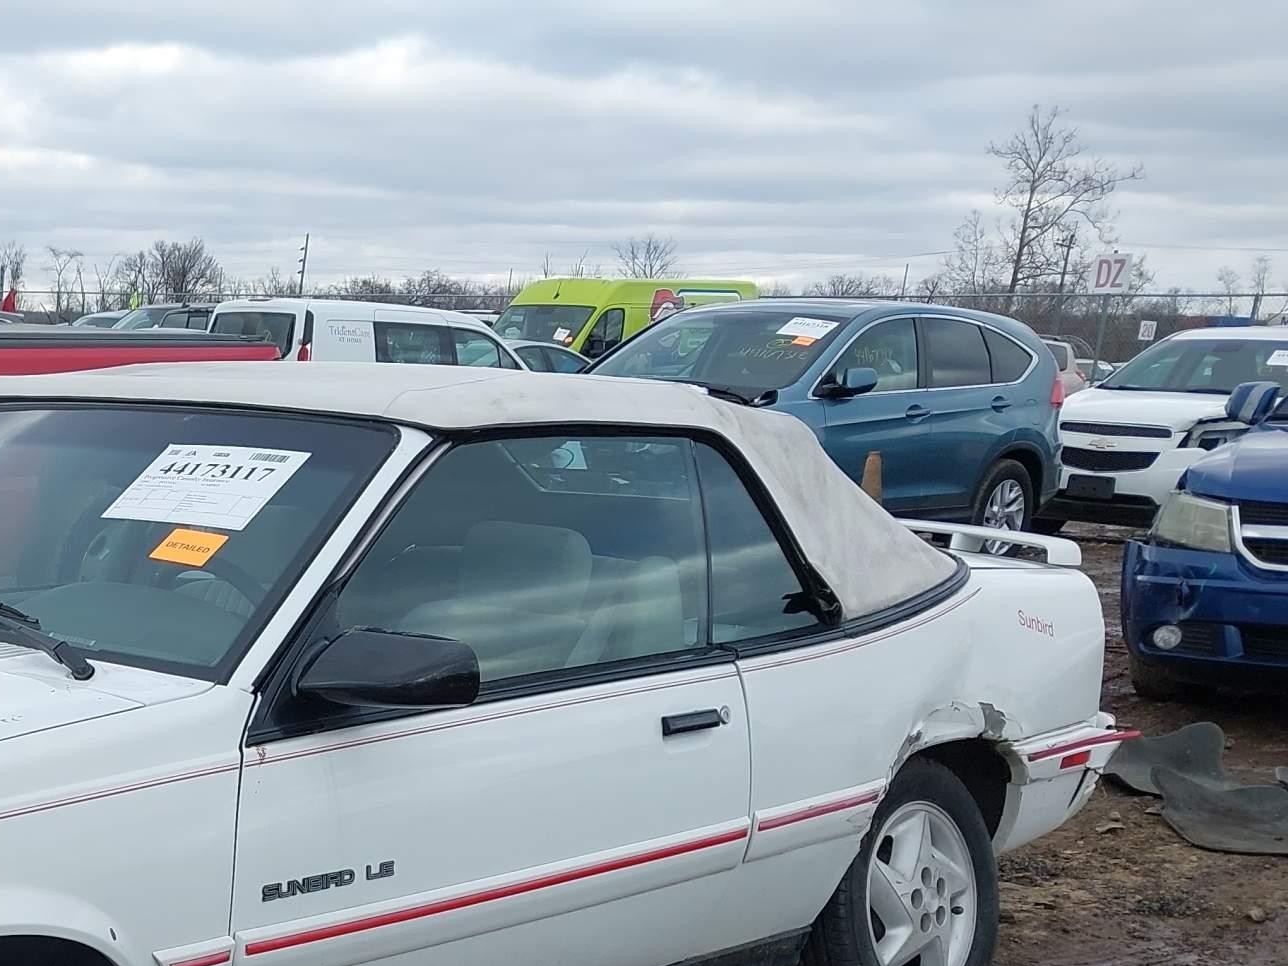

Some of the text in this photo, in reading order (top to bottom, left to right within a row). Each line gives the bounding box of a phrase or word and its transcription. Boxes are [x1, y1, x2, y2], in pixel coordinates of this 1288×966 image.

[1095, 258, 1126, 288] DZ
[160, 461, 277, 482] 44173117
[165, 540, 211, 555] DETAILED
[1017, 609, 1054, 638] Sunbird
[262, 860, 395, 902] SUNBIRD LE
